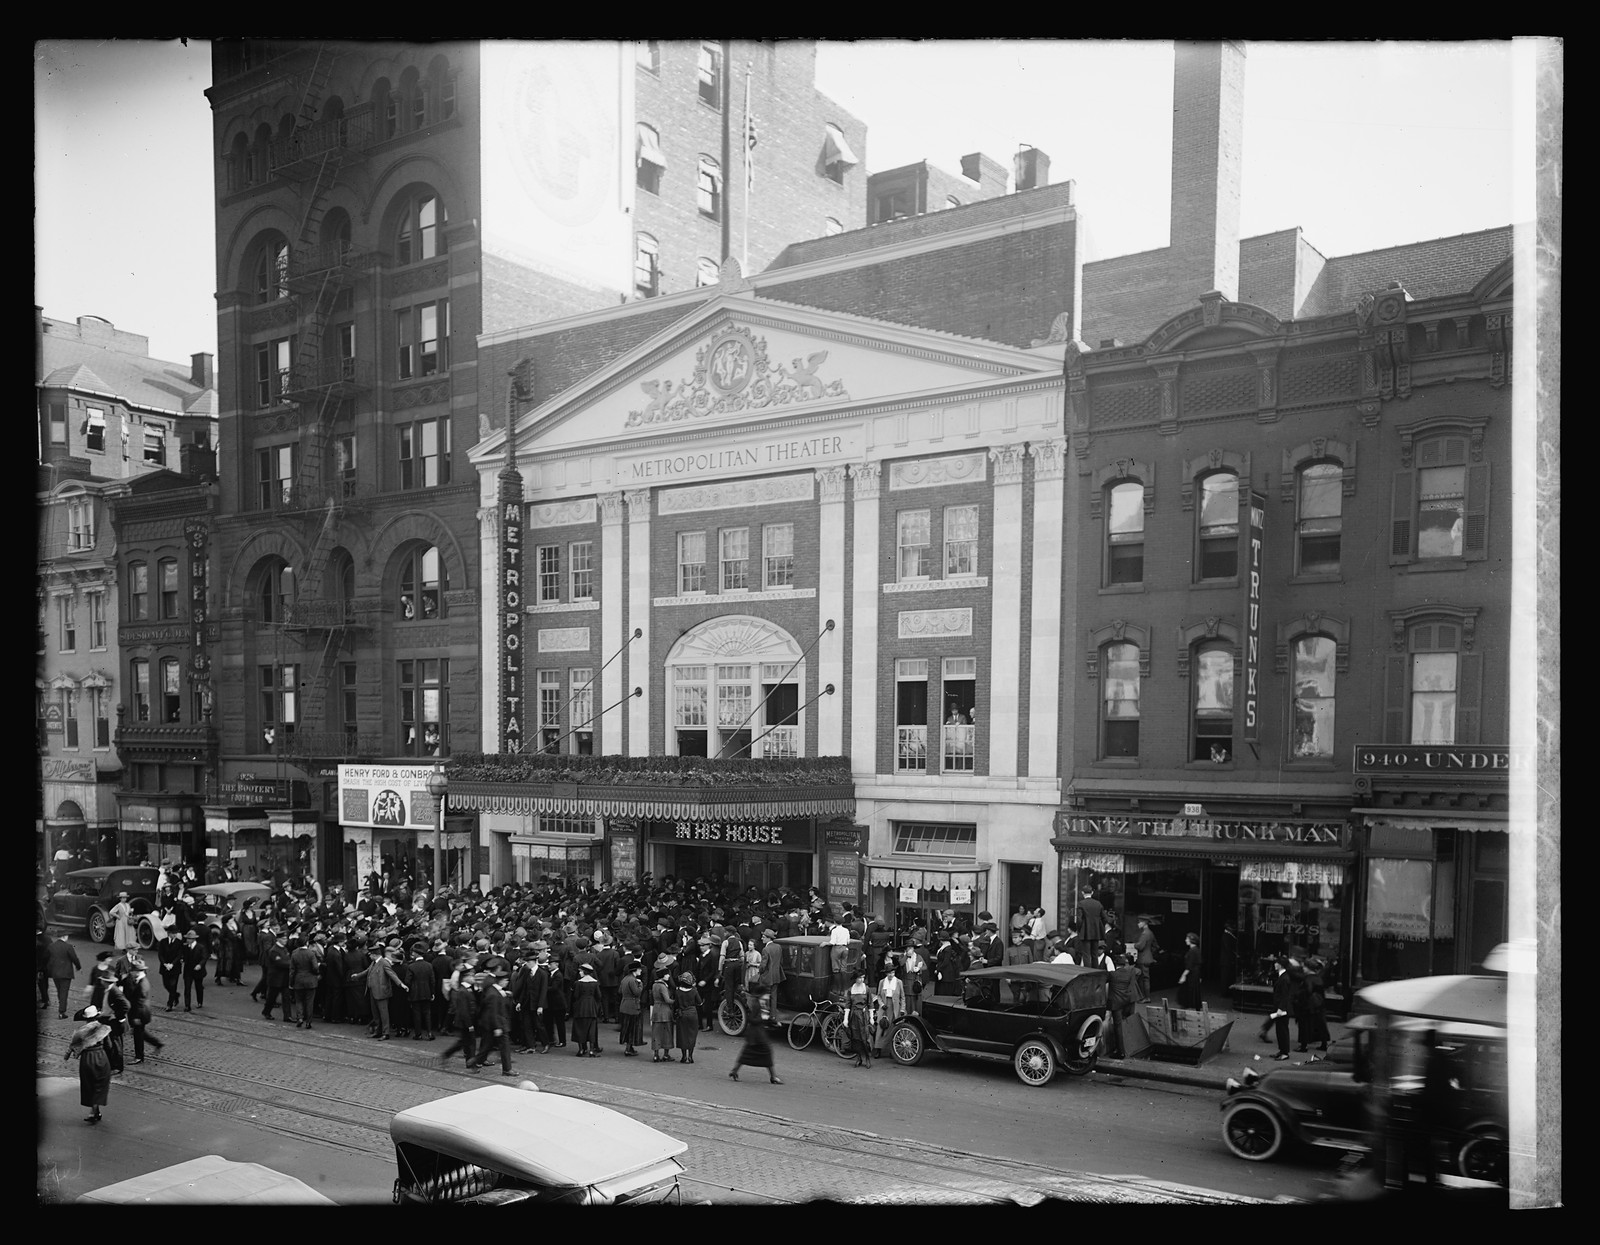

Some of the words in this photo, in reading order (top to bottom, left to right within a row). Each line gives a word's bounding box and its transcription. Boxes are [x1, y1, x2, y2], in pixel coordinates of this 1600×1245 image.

[631, 447, 759, 478] METROPOLITAN
[766, 436, 843, 462] THEATER
[505, 503, 521, 754] METROPOLITAN
[1246, 538, 1261, 727] TRUNKS
[1363, 753, 1408, 766] 940
[344, 768, 370, 778] HENRY
[372, 769, 390, 778] FORD
[392, 769, 398, 778] &
[220, 783, 236, 792] THE
[238, 782, 276, 793] BOOTERY
[230, 794, 263, 803] FOOTWEAR
[1186, 805, 1200, 814] 938
[675, 822, 692, 839] IN
[694, 823, 722, 840] HIS
[725, 824, 783, 845] HOUSE
[826, 830, 861, 840] METROPOLITAN
[1063, 818, 1130, 834] MINTZ
[1137, 821, 1183, 836] THE
[1192, 823, 1276, 840] TRUNK
[1284, 826, 1339, 842] MAN
[1067, 858, 1115, 870] TRUNKS
[1251, 869, 1280, 878] SUIT
[1285, 871, 1332, 881] CASES
[1257, 922, 1320, 936] MTZ'S
